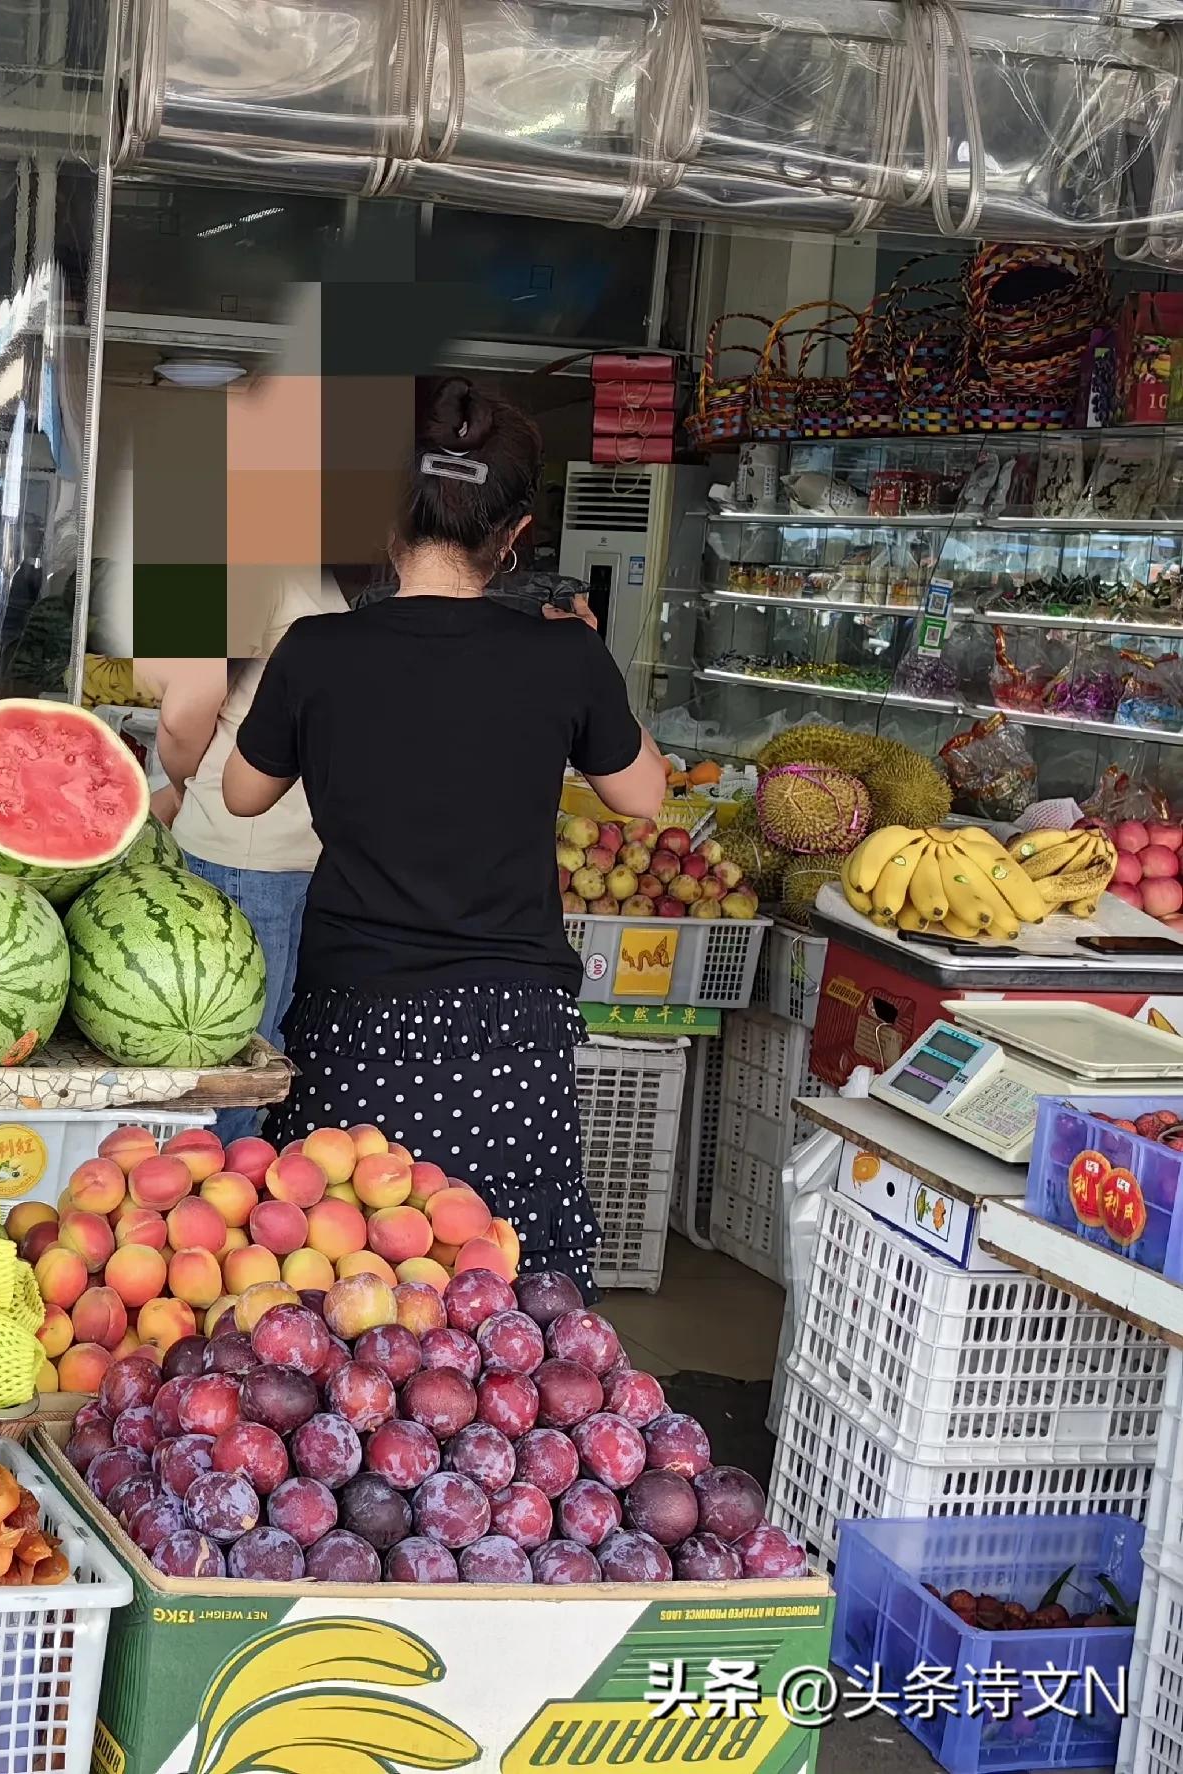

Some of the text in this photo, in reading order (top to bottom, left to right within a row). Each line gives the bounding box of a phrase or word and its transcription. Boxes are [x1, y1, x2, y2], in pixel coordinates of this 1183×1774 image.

[608, 1005, 697, 1025] 天然干果
[153, 1607, 269, 1624] NET WEIGHT 13KG
[528, 1715, 769, 1766] BANANA
